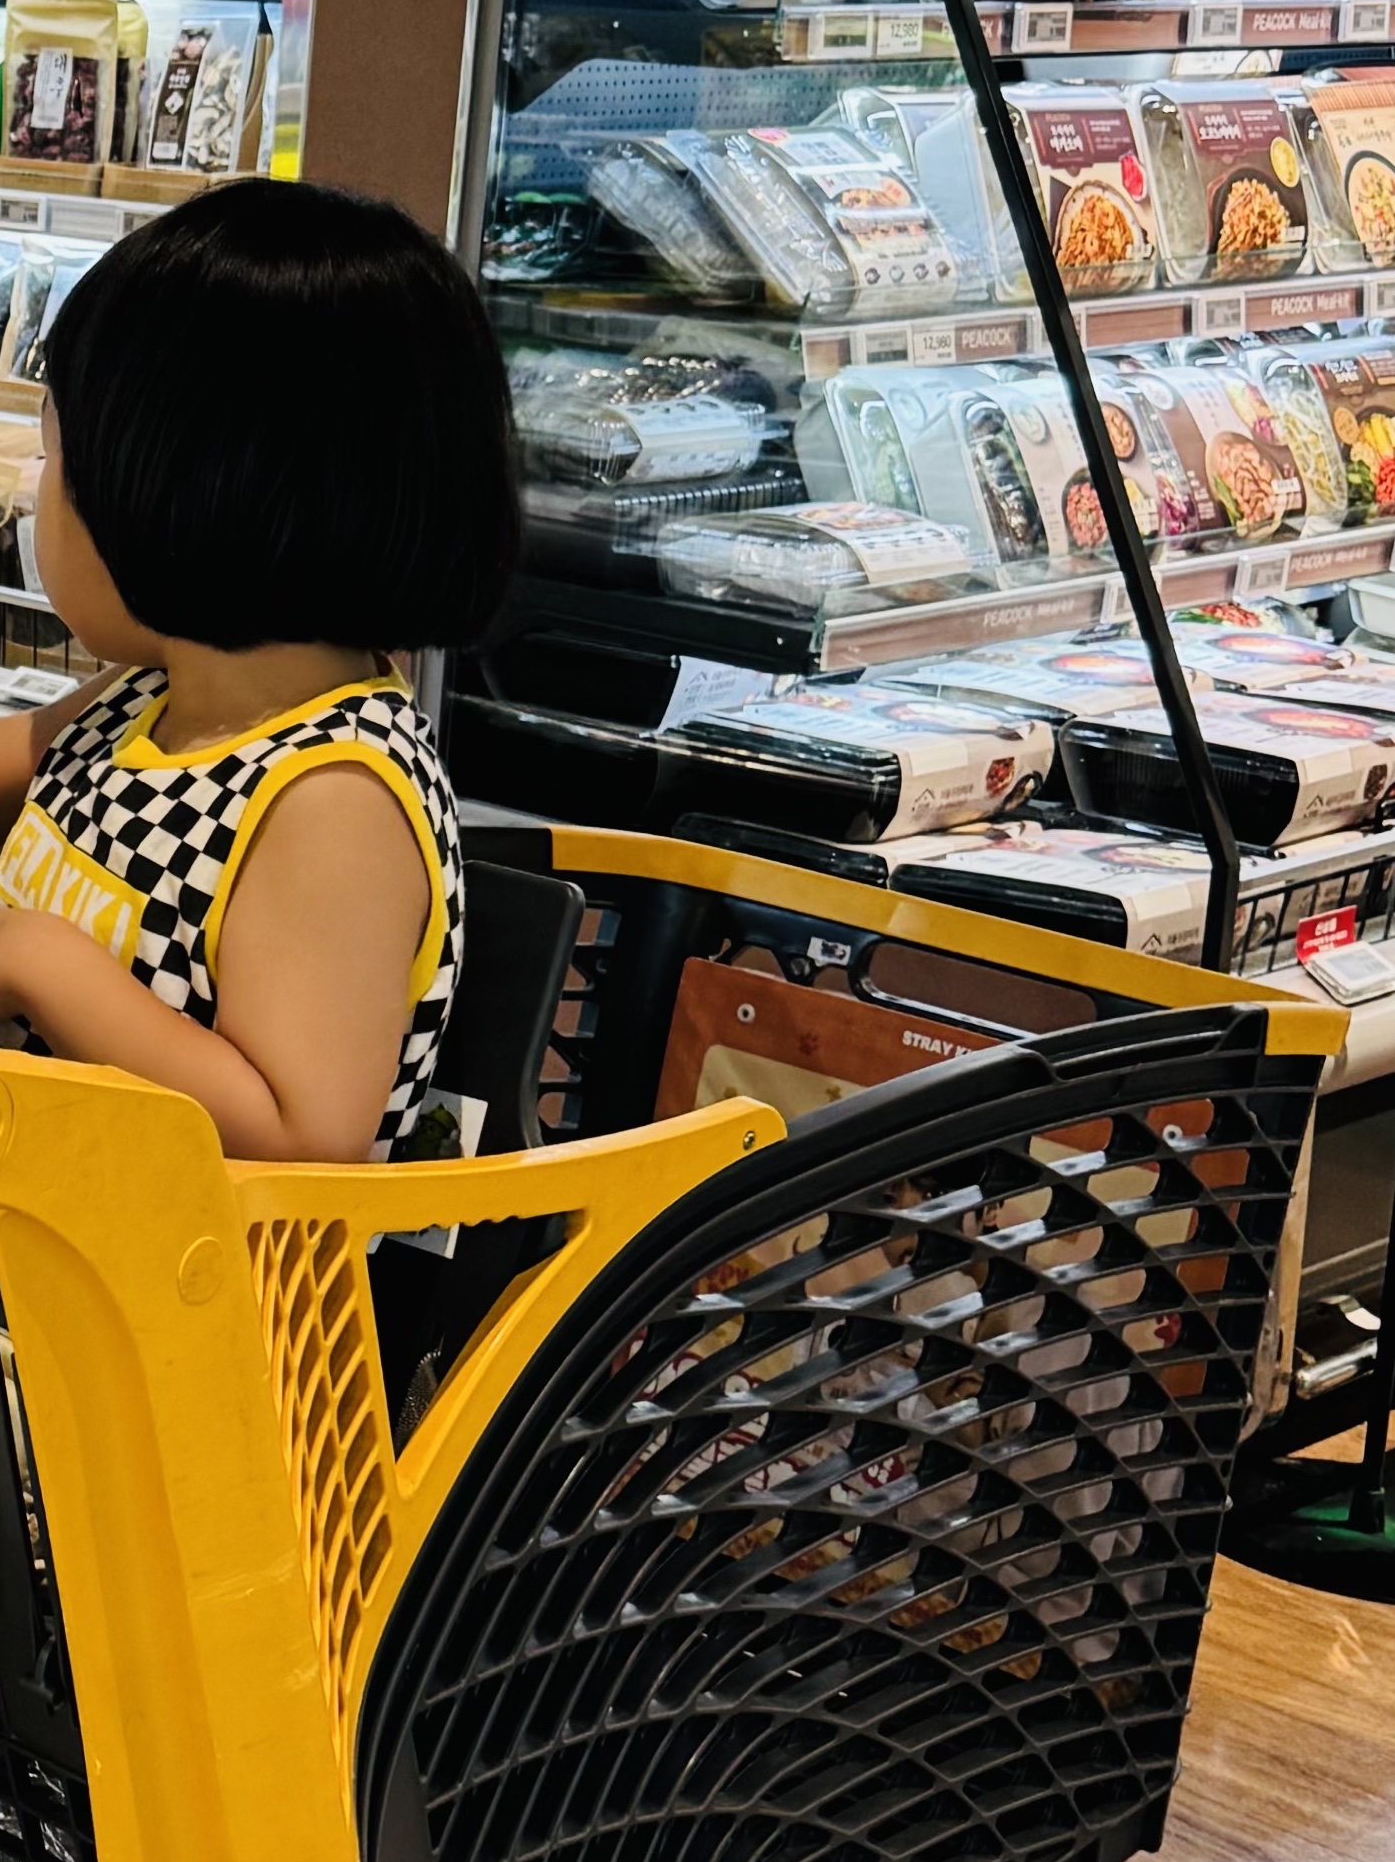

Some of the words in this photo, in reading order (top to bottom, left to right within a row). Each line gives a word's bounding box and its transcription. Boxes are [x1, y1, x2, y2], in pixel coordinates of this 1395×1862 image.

[1252, 11, 1296, 31] PEACOCK
[1271, 297, 1313, 316] PEACOCK
[961, 327, 1012, 350] PEACOCK
[901, 1029, 953, 1056] STRAY
